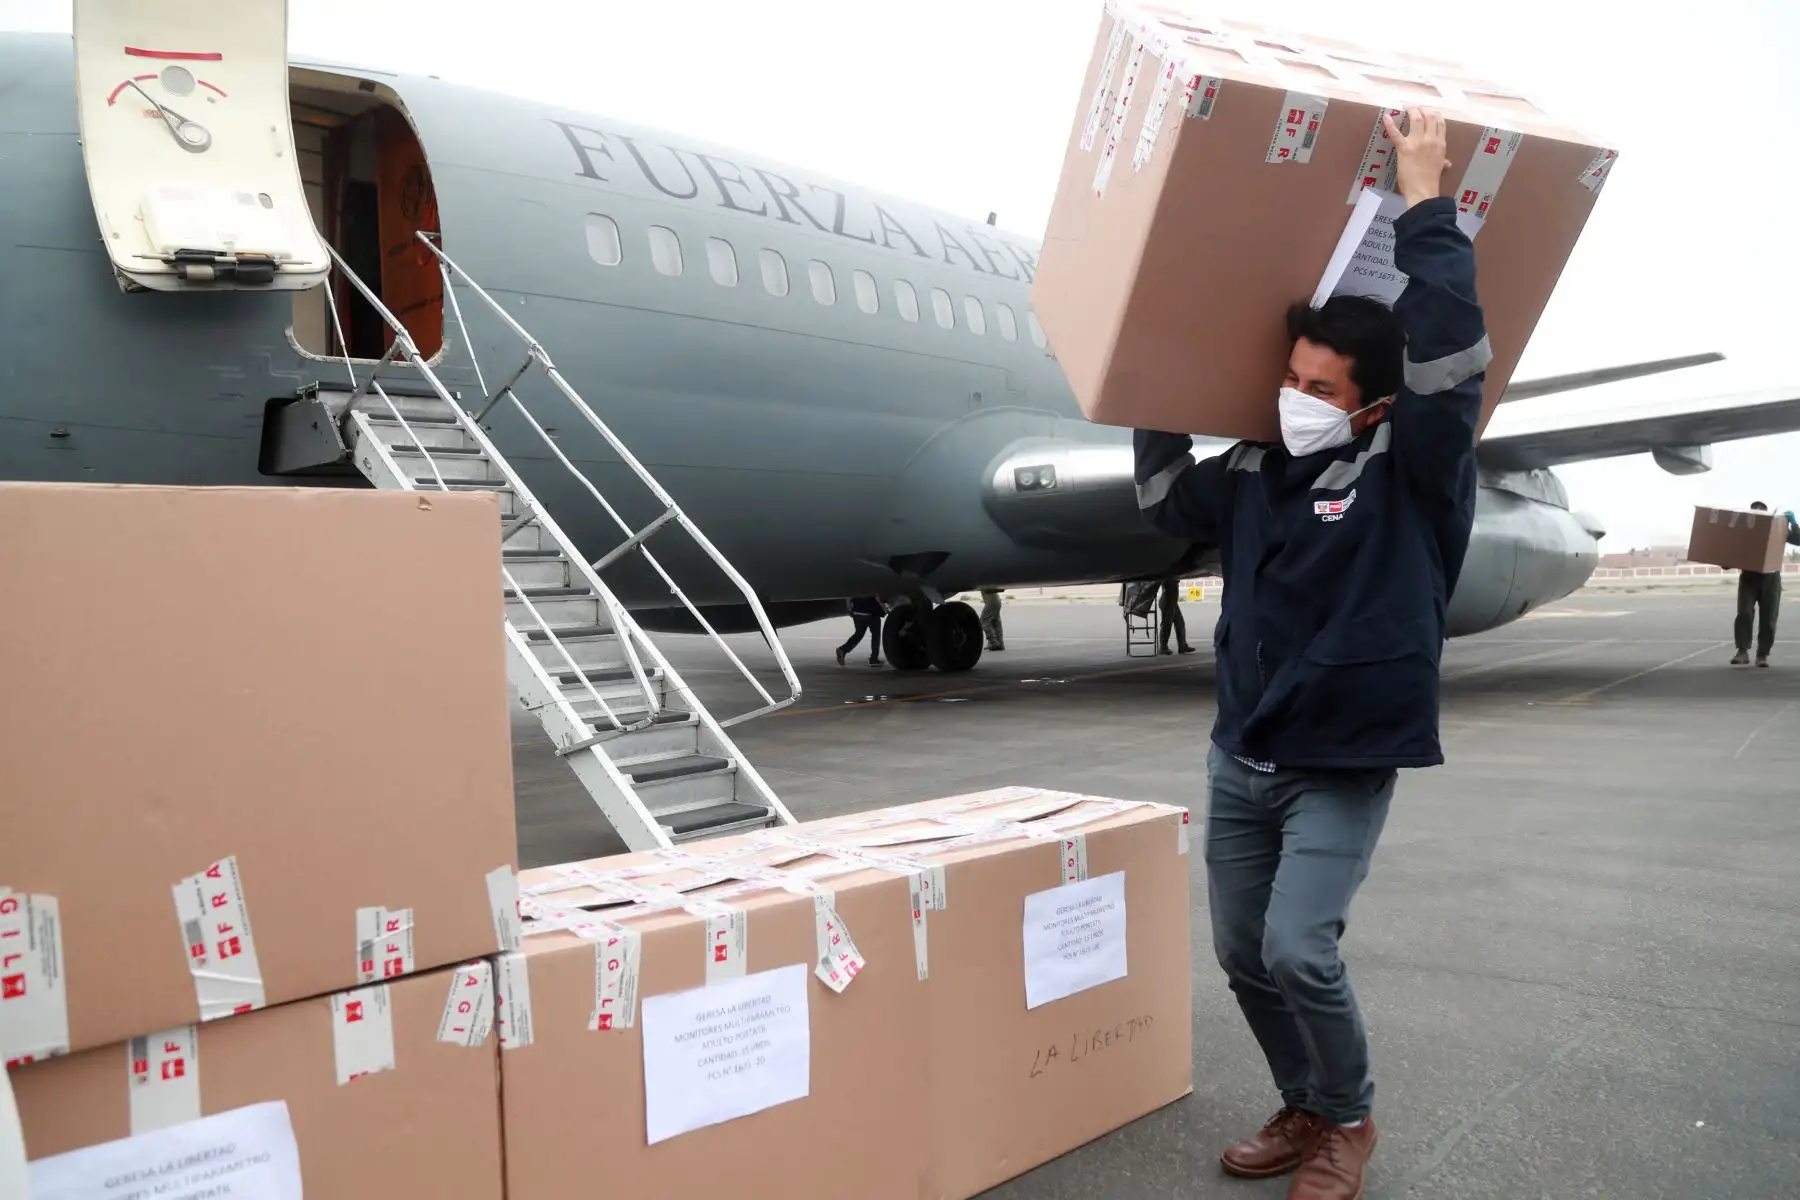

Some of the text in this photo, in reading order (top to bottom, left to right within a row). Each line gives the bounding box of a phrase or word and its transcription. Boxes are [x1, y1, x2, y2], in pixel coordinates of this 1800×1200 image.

[545, 118, 932, 259] FUERZA
[1361, 239, 1392, 252] ADULTO
[1353, 266, 1368, 276] PCS
[1378, 272, 1395, 282] 1673
[727, 1004, 737, 1014] LA
[674, 1023, 724, 1044] MONITORES
[702, 1034, 735, 1050] ADULTO
[1029, 1014, 1154, 1078] LA LIBERTAD
